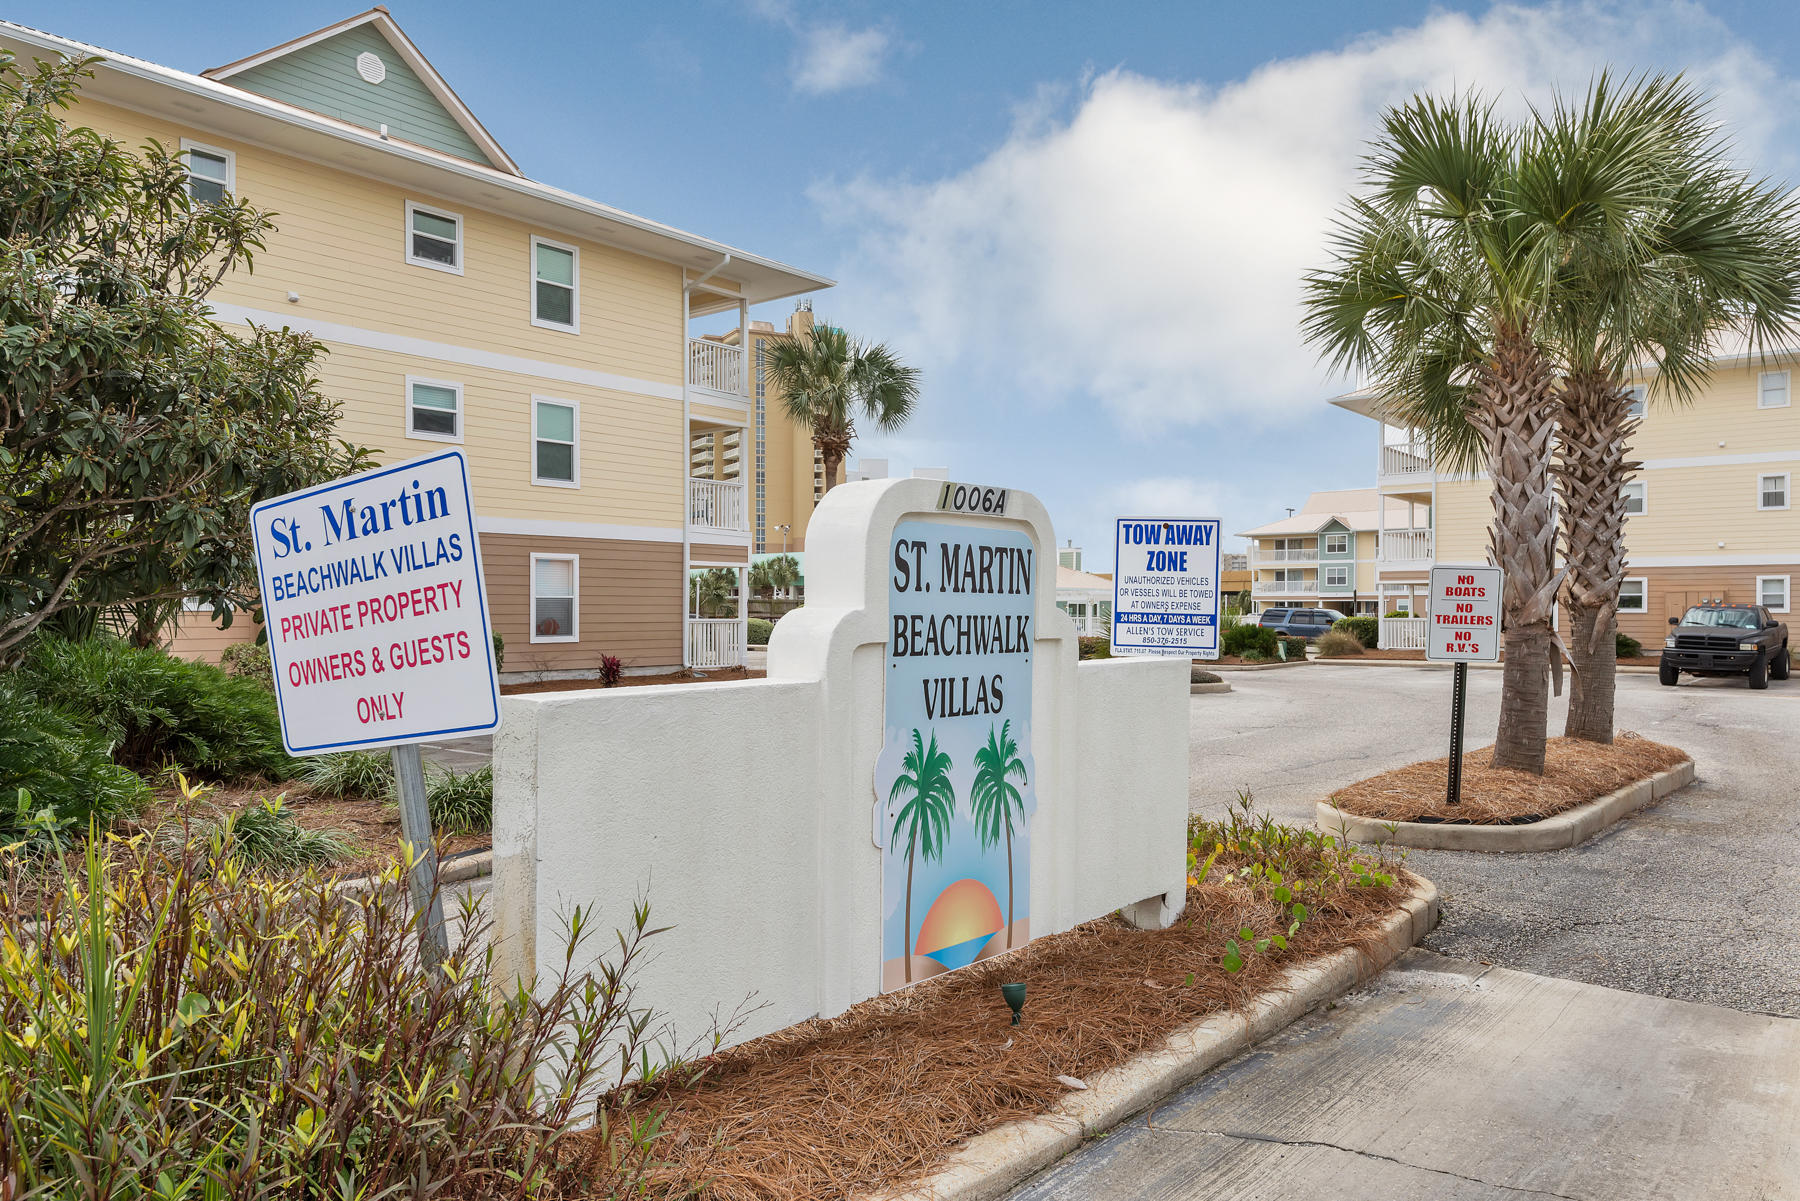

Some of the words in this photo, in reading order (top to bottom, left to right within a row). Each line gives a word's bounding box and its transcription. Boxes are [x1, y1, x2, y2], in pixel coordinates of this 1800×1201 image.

[941, 484, 1006, 514] 1006A
[270, 515, 312, 559] St.
[319, 479, 450, 547] Martin
[1123, 524, 1161, 544] TOW
[1165, 525, 1213, 545] AWAY
[272, 551, 387, 601] BEACHWALK
[390, 533, 463, 574] VILLAS
[894, 539, 930, 593] ST.
[940, 543, 1033, 595] MARTIN
[1147, 551, 1187, 572] ZONE
[1124, 576, 1175, 585] UNAUTHORIZED
[1177, 577, 1208, 585] VEHICLES
[1458, 575, 1474, 584] NO
[1120, 588, 1128, 596] OR
[1131, 589, 1159, 597] VESSELS
[1161, 589, 1177, 598] WILL
[1179, 590, 1187, 598] BE
[1446, 587, 1485, 597] BOATS
[281, 604, 353, 643] PRIVATE
[357, 580, 463, 627] PROPERTY
[1131, 601, 1139, 609] AT
[1141, 602, 1169, 610] OWNERS
[1456, 603, 1472, 612] NO
[1121, 614, 1129, 622] 24
[1148, 615, 1162, 624] DAY,
[1435, 614, 1493, 625] TRAILERS
[893, 614, 1030, 657] BEACHWALK
[1126, 627, 1155, 635] ALLEN'S
[1157, 628, 1174, 636] TOW
[1176, 628, 1204, 636] SERVICE
[1455, 631, 1471, 640] NO
[288, 649, 366, 687] OWNERS
[372, 647, 385, 674] &
[389, 630, 471, 670] GUESTS
[923, 674, 1004, 720] VILLAS
[357, 692, 404, 724] ONLY
